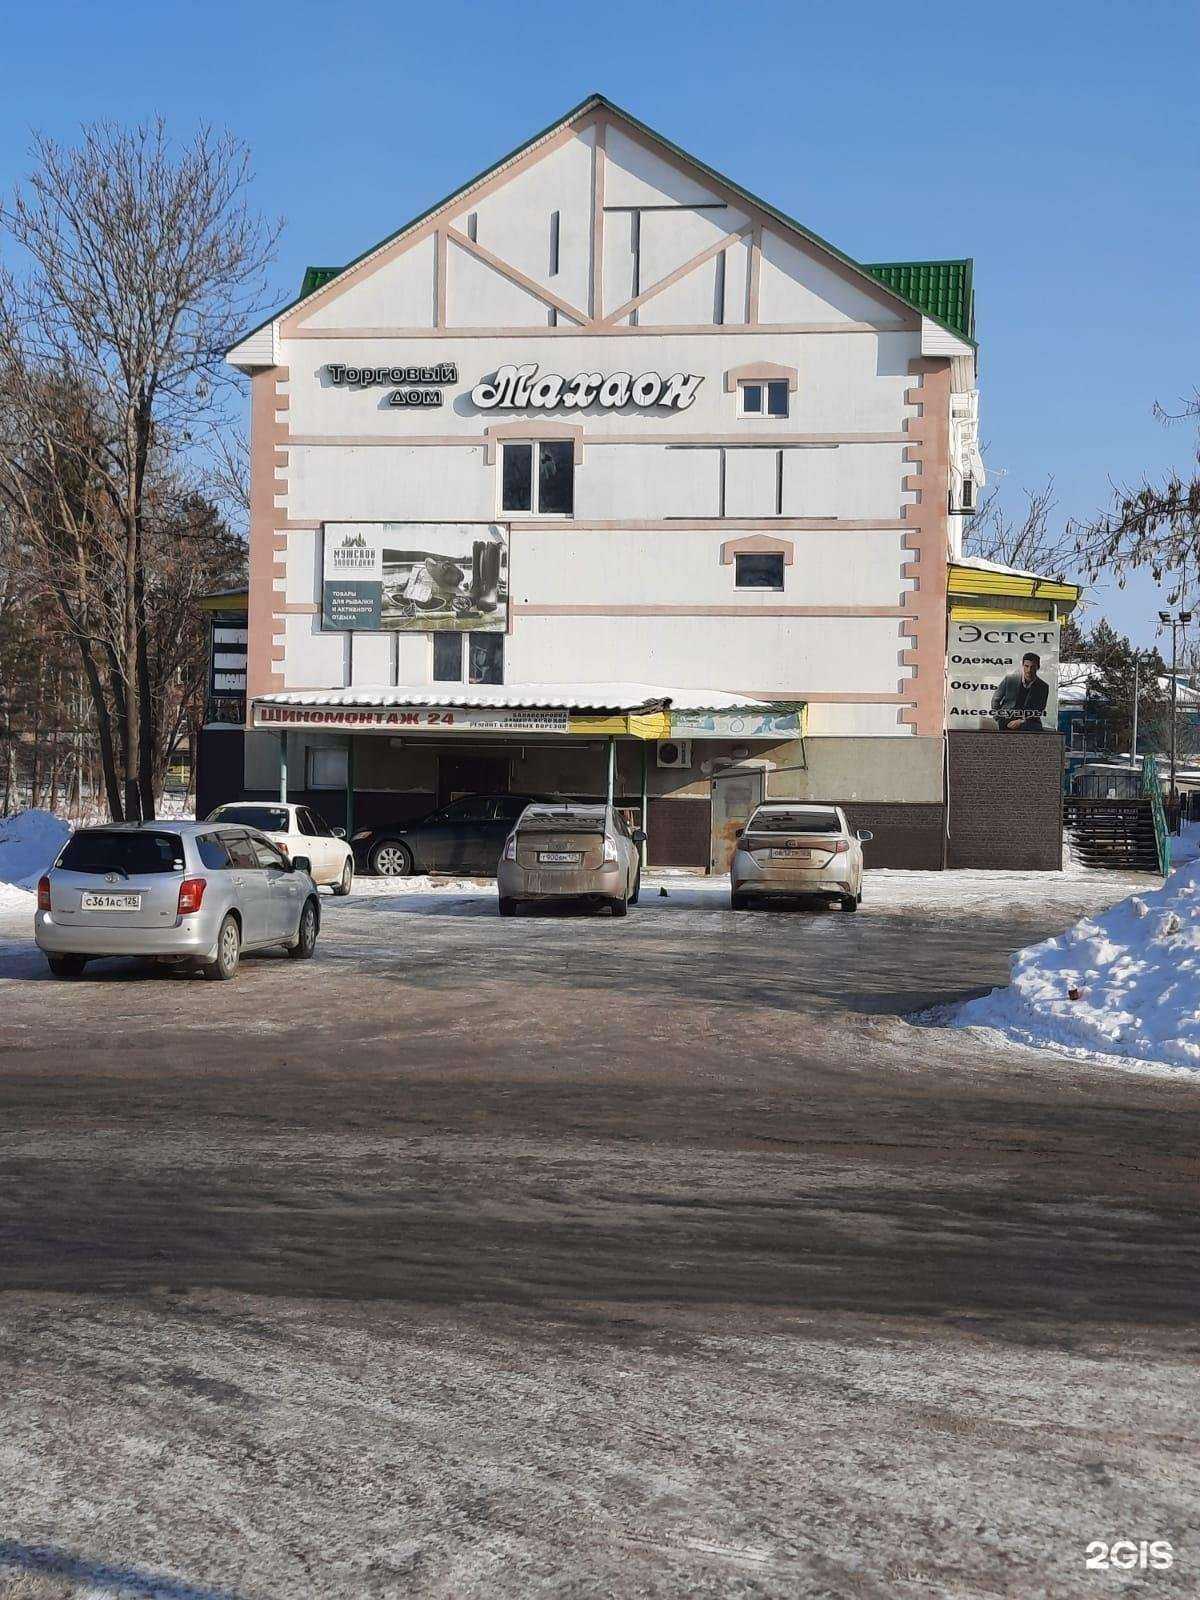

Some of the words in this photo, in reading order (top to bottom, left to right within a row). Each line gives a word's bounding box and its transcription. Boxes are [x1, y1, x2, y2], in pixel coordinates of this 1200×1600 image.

[329, 362, 458, 385] Торговый
[471, 363, 705, 409] Махаон
[958, 625, 1054, 644] Эстет
[951, 655, 1013, 666] Одежда
[950, 681, 998, 692] Обувь
[261, 708, 420, 725] ШИНОМОНТАЖ
[427, 711, 455, 725] 24
[950, 706, 1047, 718] Аксессуары
